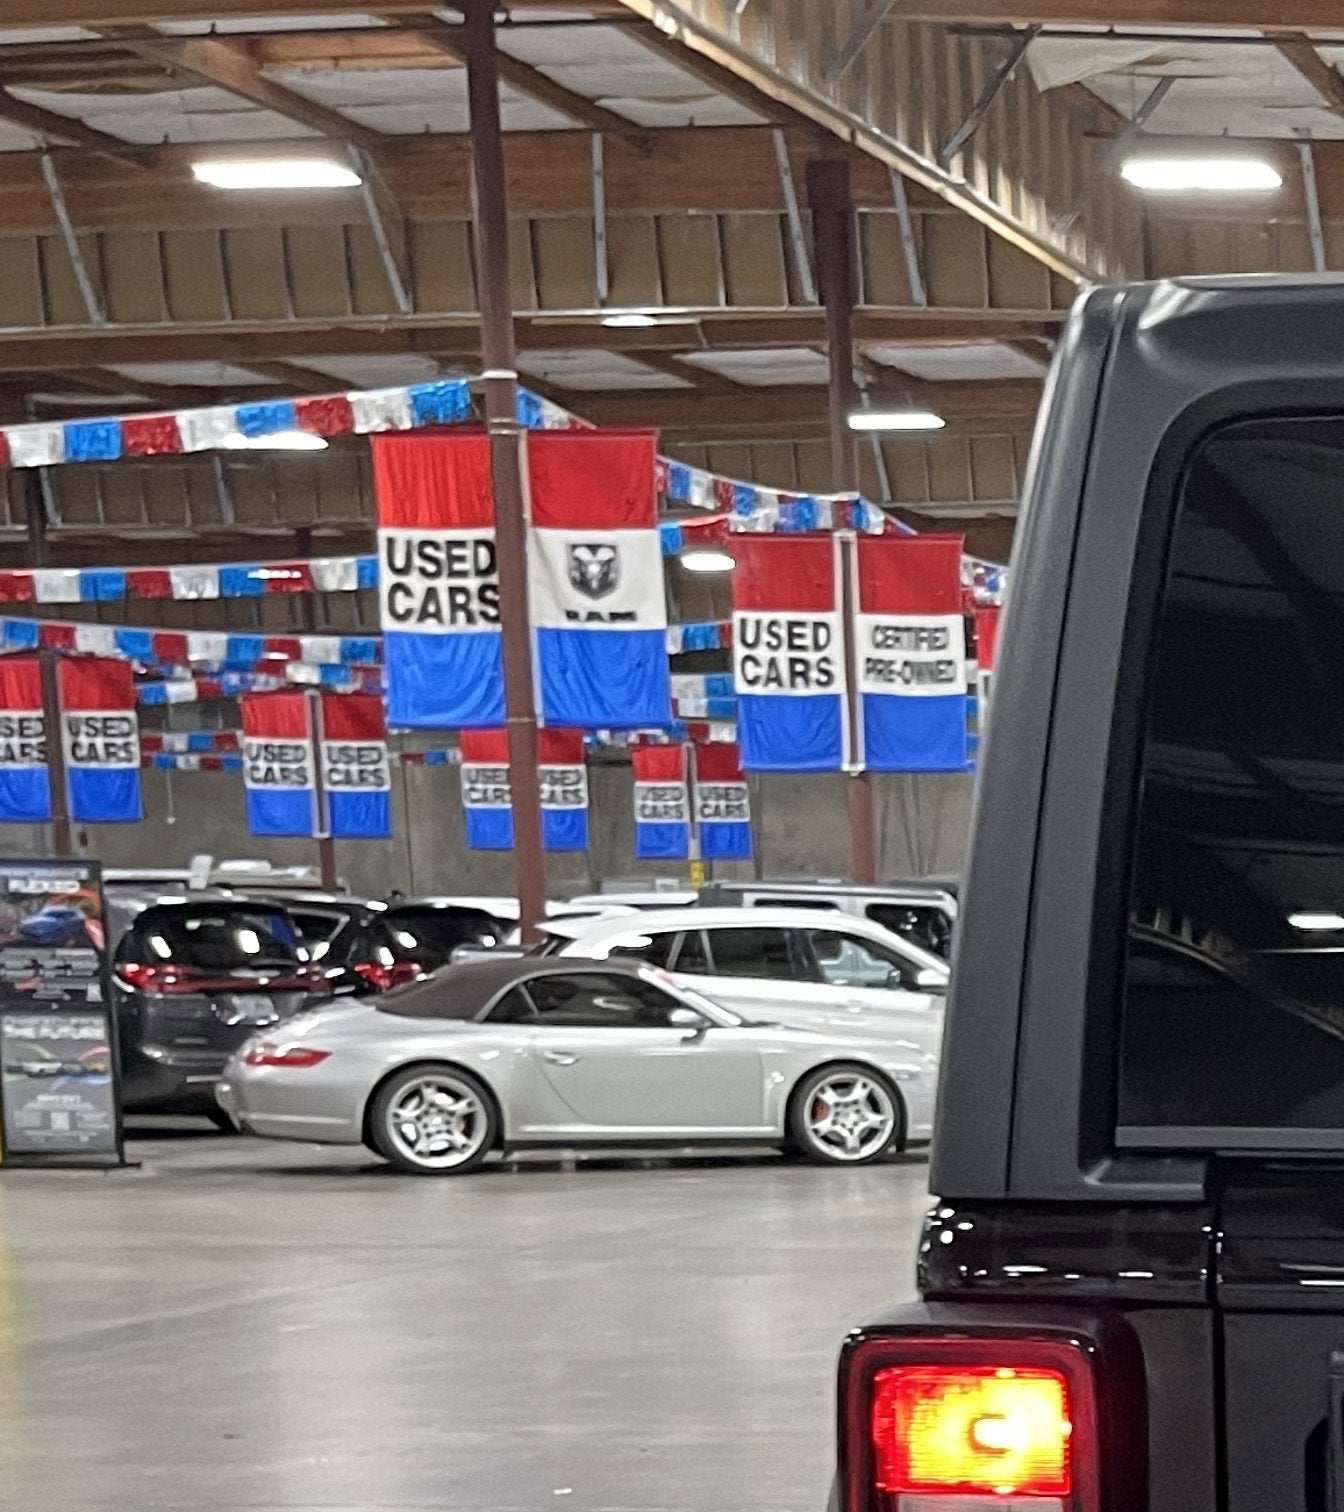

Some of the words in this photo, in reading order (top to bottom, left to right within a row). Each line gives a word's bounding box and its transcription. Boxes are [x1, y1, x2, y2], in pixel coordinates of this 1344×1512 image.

[386, 537, 496, 579] USED
[387, 582, 499, 625] CARS
[739, 618, 831, 651] USED
[740, 654, 835, 688] CARS
[0, 716, 46, 739] SED
[67, 716, 133, 738] USED
[71, 742, 134, 763] CARS
[248, 743, 306, 763] USED
[327, 746, 382, 765] USED
[250, 765, 308, 785] CARS
[328, 767, 385, 786] CARS
